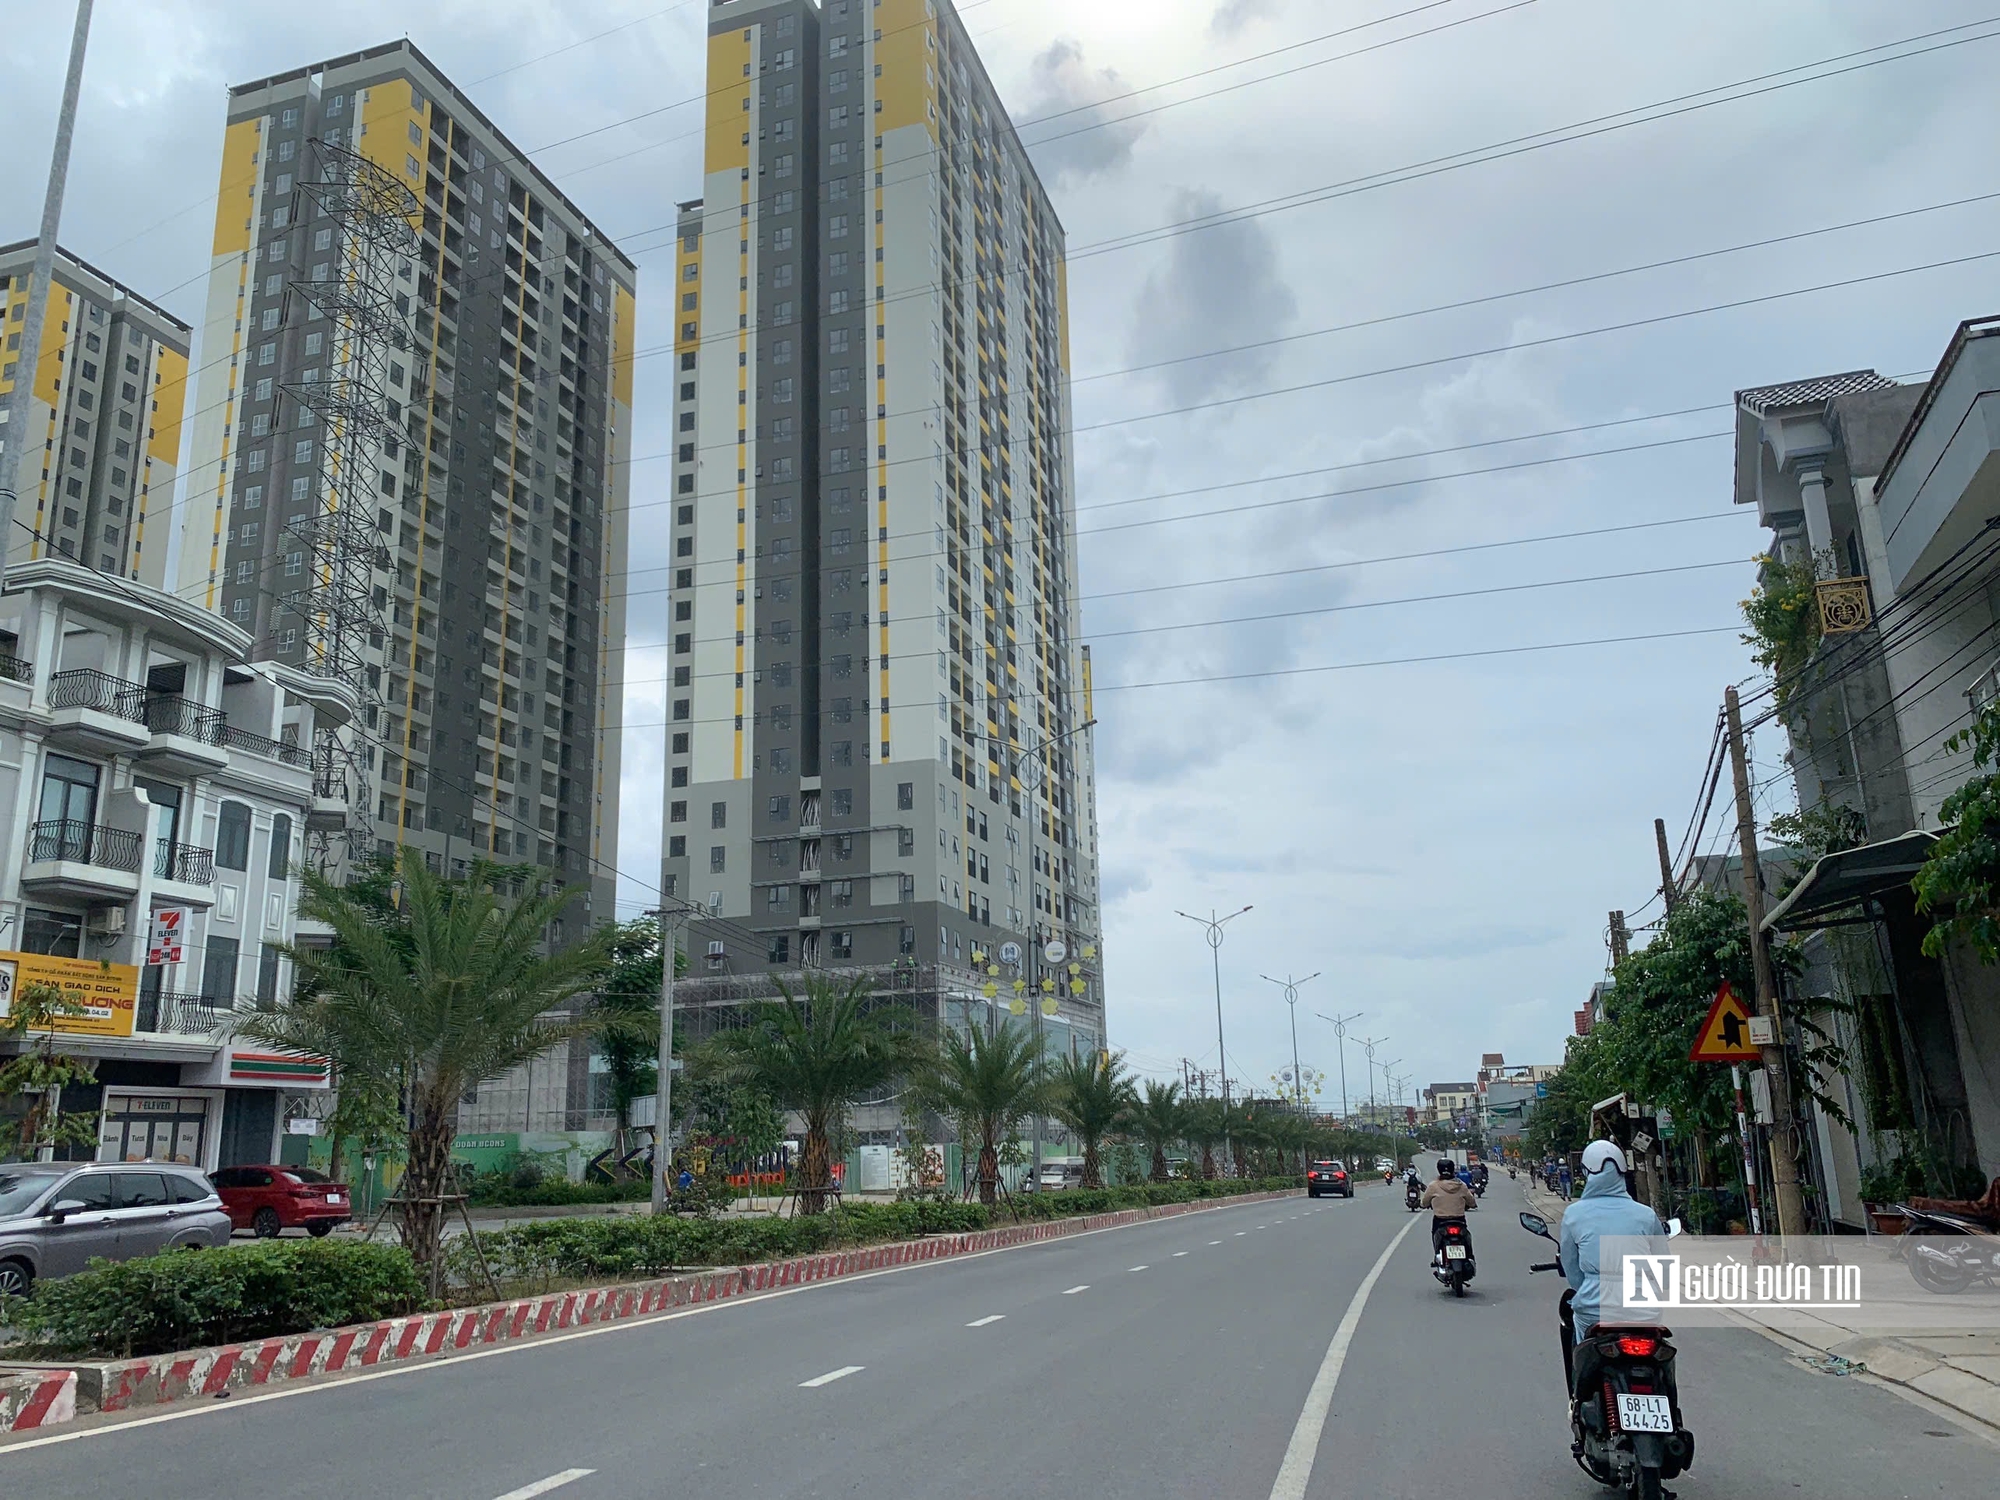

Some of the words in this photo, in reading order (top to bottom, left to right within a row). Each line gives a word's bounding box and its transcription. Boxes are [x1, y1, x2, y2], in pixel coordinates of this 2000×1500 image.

[160, 911, 180, 929] 7
[65, 982, 91, 991] GIAO
[95, 985, 120, 995] DỊCH
[1626, 1397, 1660, 1413] 68-L1
[1623, 1413, 1670, 1430] 344.25
